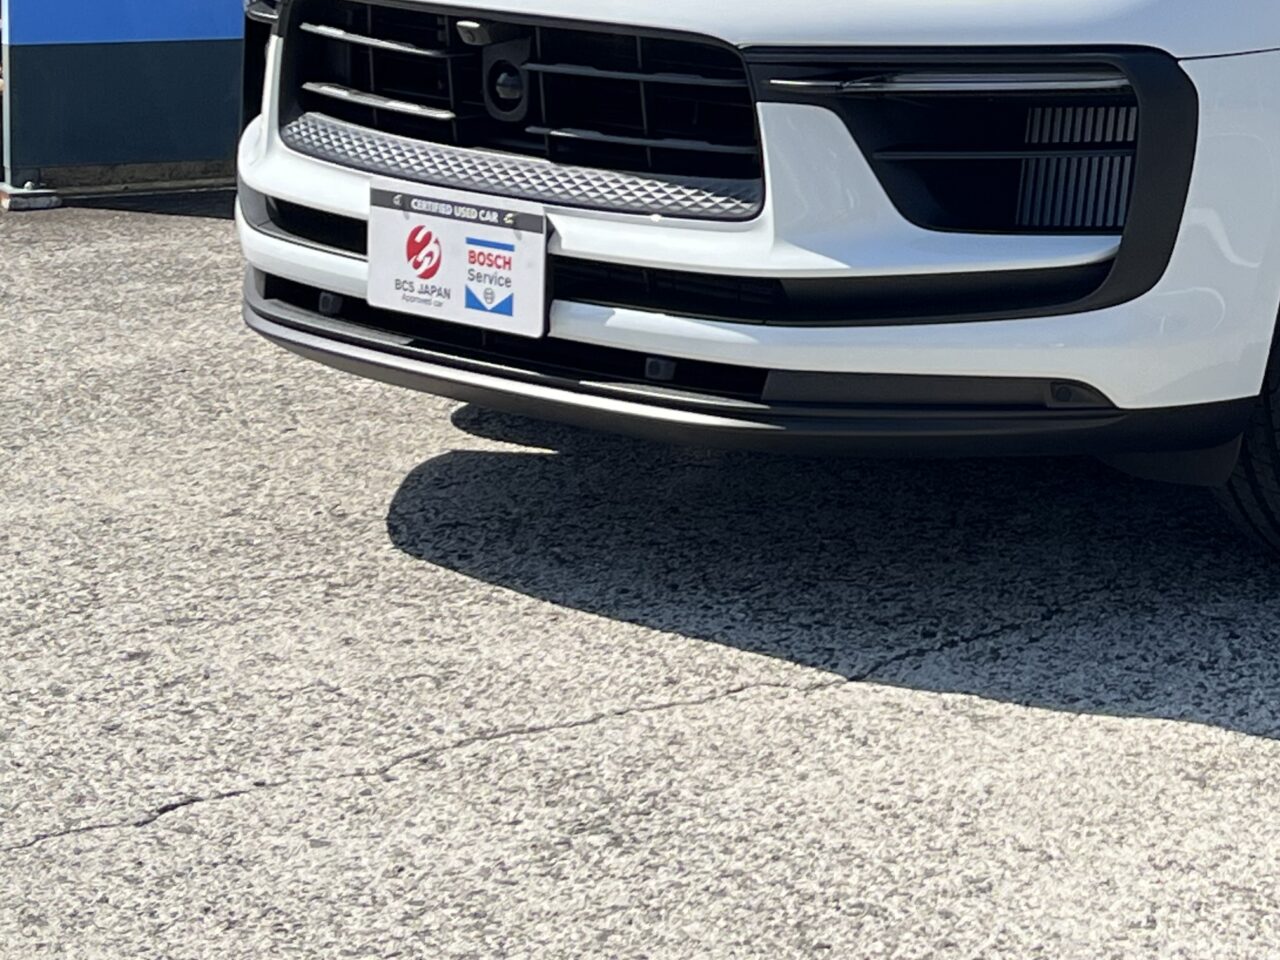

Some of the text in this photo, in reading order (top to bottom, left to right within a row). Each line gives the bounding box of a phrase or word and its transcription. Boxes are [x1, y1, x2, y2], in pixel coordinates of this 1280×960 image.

[454, 205, 478, 220] USED
[478, 210, 499, 224] CAR
[467, 249, 512, 271] BOSCH
[467, 268, 512, 288] Service
[394, 278, 451, 300] BCS JAPAN
